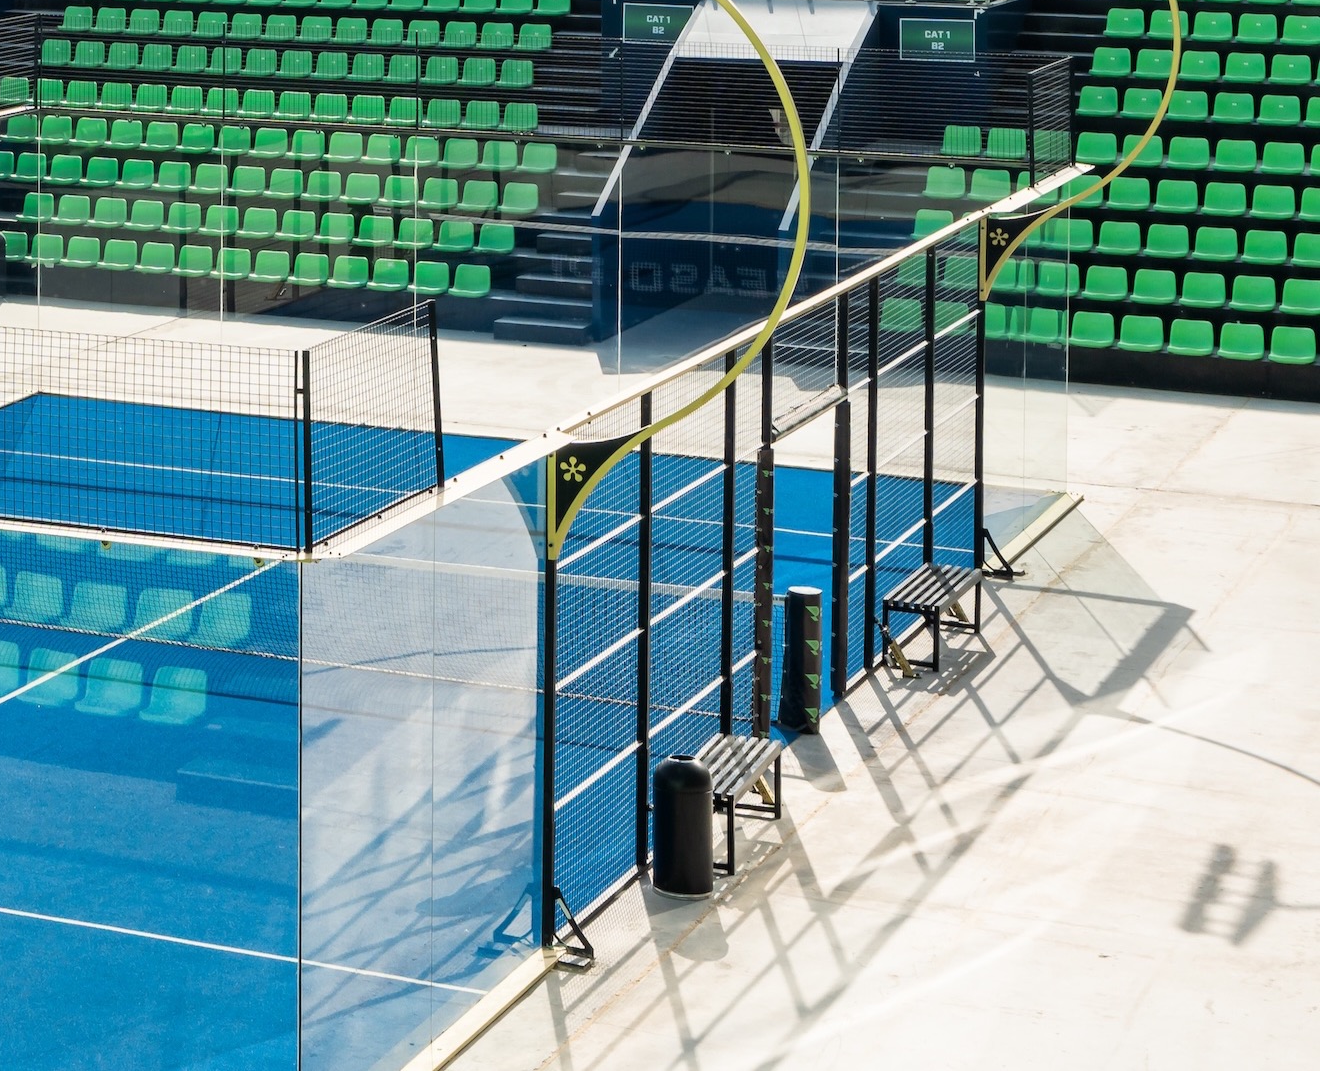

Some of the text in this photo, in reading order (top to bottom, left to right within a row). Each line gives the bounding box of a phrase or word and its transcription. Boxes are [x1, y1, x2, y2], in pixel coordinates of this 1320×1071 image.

[646, 15, 664, 23] CAT
[652, 26, 664, 34] B2
[925, 30, 950, 39] CAT 1
[931, 42, 944, 50] B2
